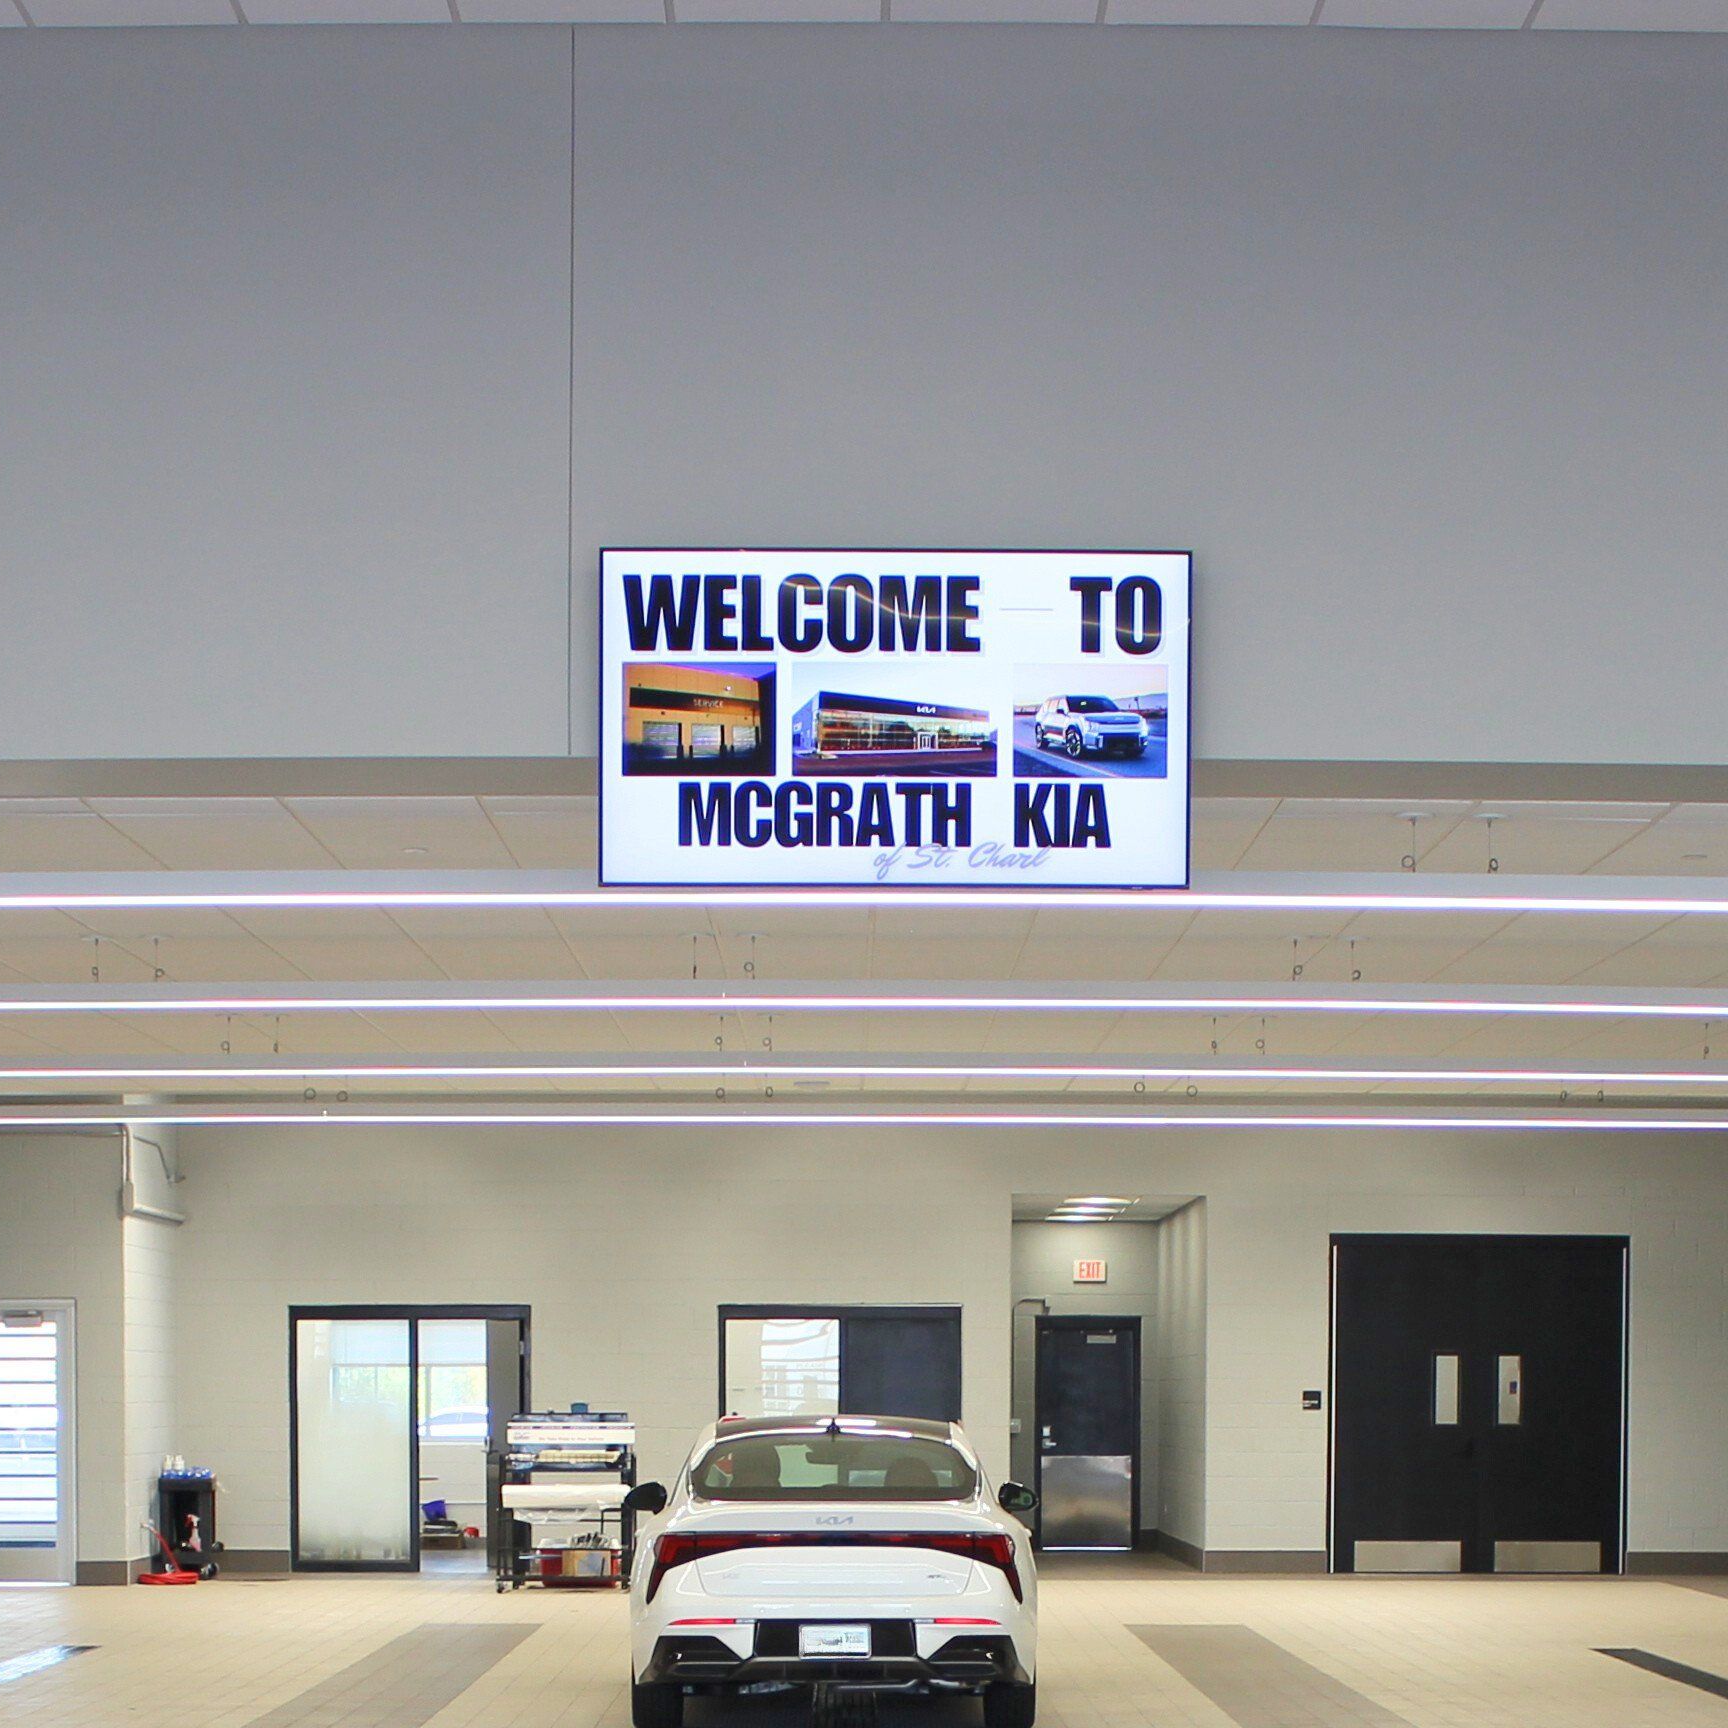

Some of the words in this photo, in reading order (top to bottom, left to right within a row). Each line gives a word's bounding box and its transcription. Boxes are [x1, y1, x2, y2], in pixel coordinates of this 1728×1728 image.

[622, 574, 981, 653] WELCOME
[1070, 575, 1163, 655] TO
[677, 780, 973, 848] MCGRATH
[1012, 781, 1112, 849] KIA
[873, 841, 908, 880] of
[906, 842, 959, 869] St.
[1079, 1261, 1101, 1279] EXIT
